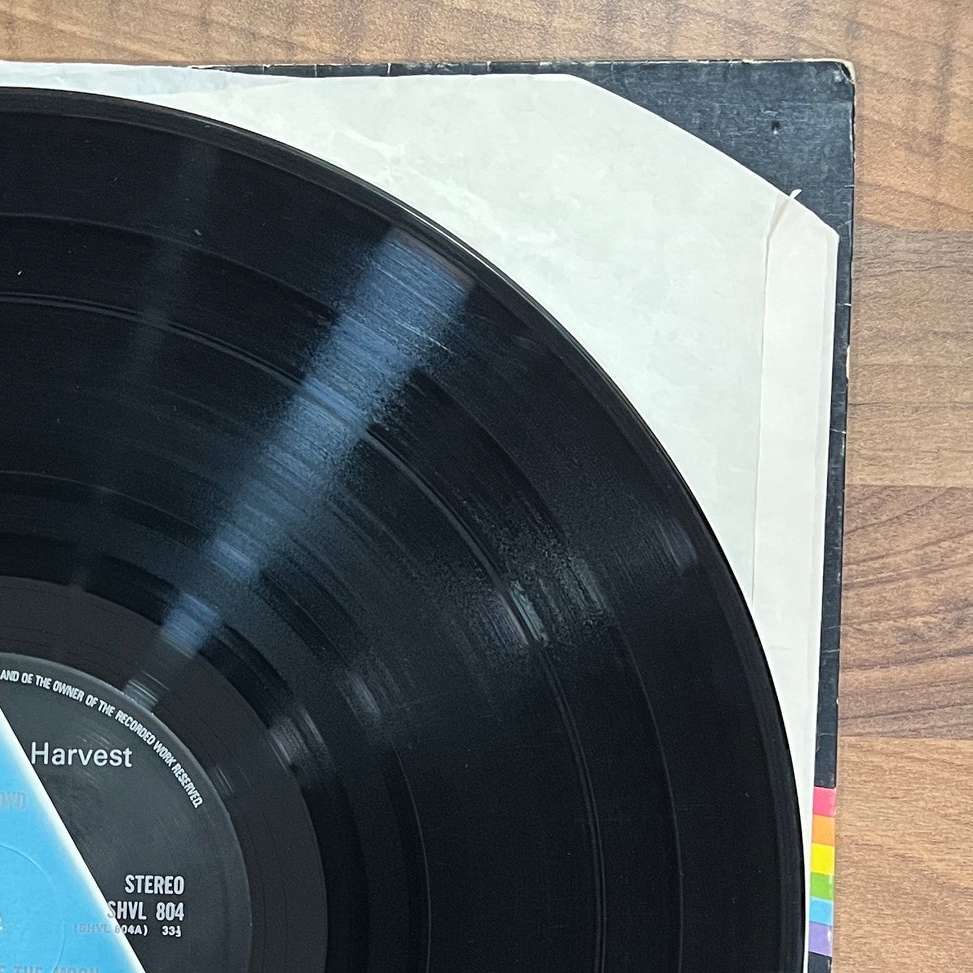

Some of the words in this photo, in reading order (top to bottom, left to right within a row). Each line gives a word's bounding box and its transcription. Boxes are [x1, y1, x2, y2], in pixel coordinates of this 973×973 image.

[0, 670, 19, 682] AND
[35, 675, 51, 690] THE
[53, 681, 85, 702] OWNER
[86, 694, 97, 708] OF
[97, 700, 115, 717] THE
[115, 710, 155, 745] RECORDED
[153, 741, 176, 768] WORK
[31, 742, 133, 768] Harvest
[125, 875, 185, 894] STEREO
[107, 901, 147, 920] SHVL
[156, 902, 184, 921] 804
